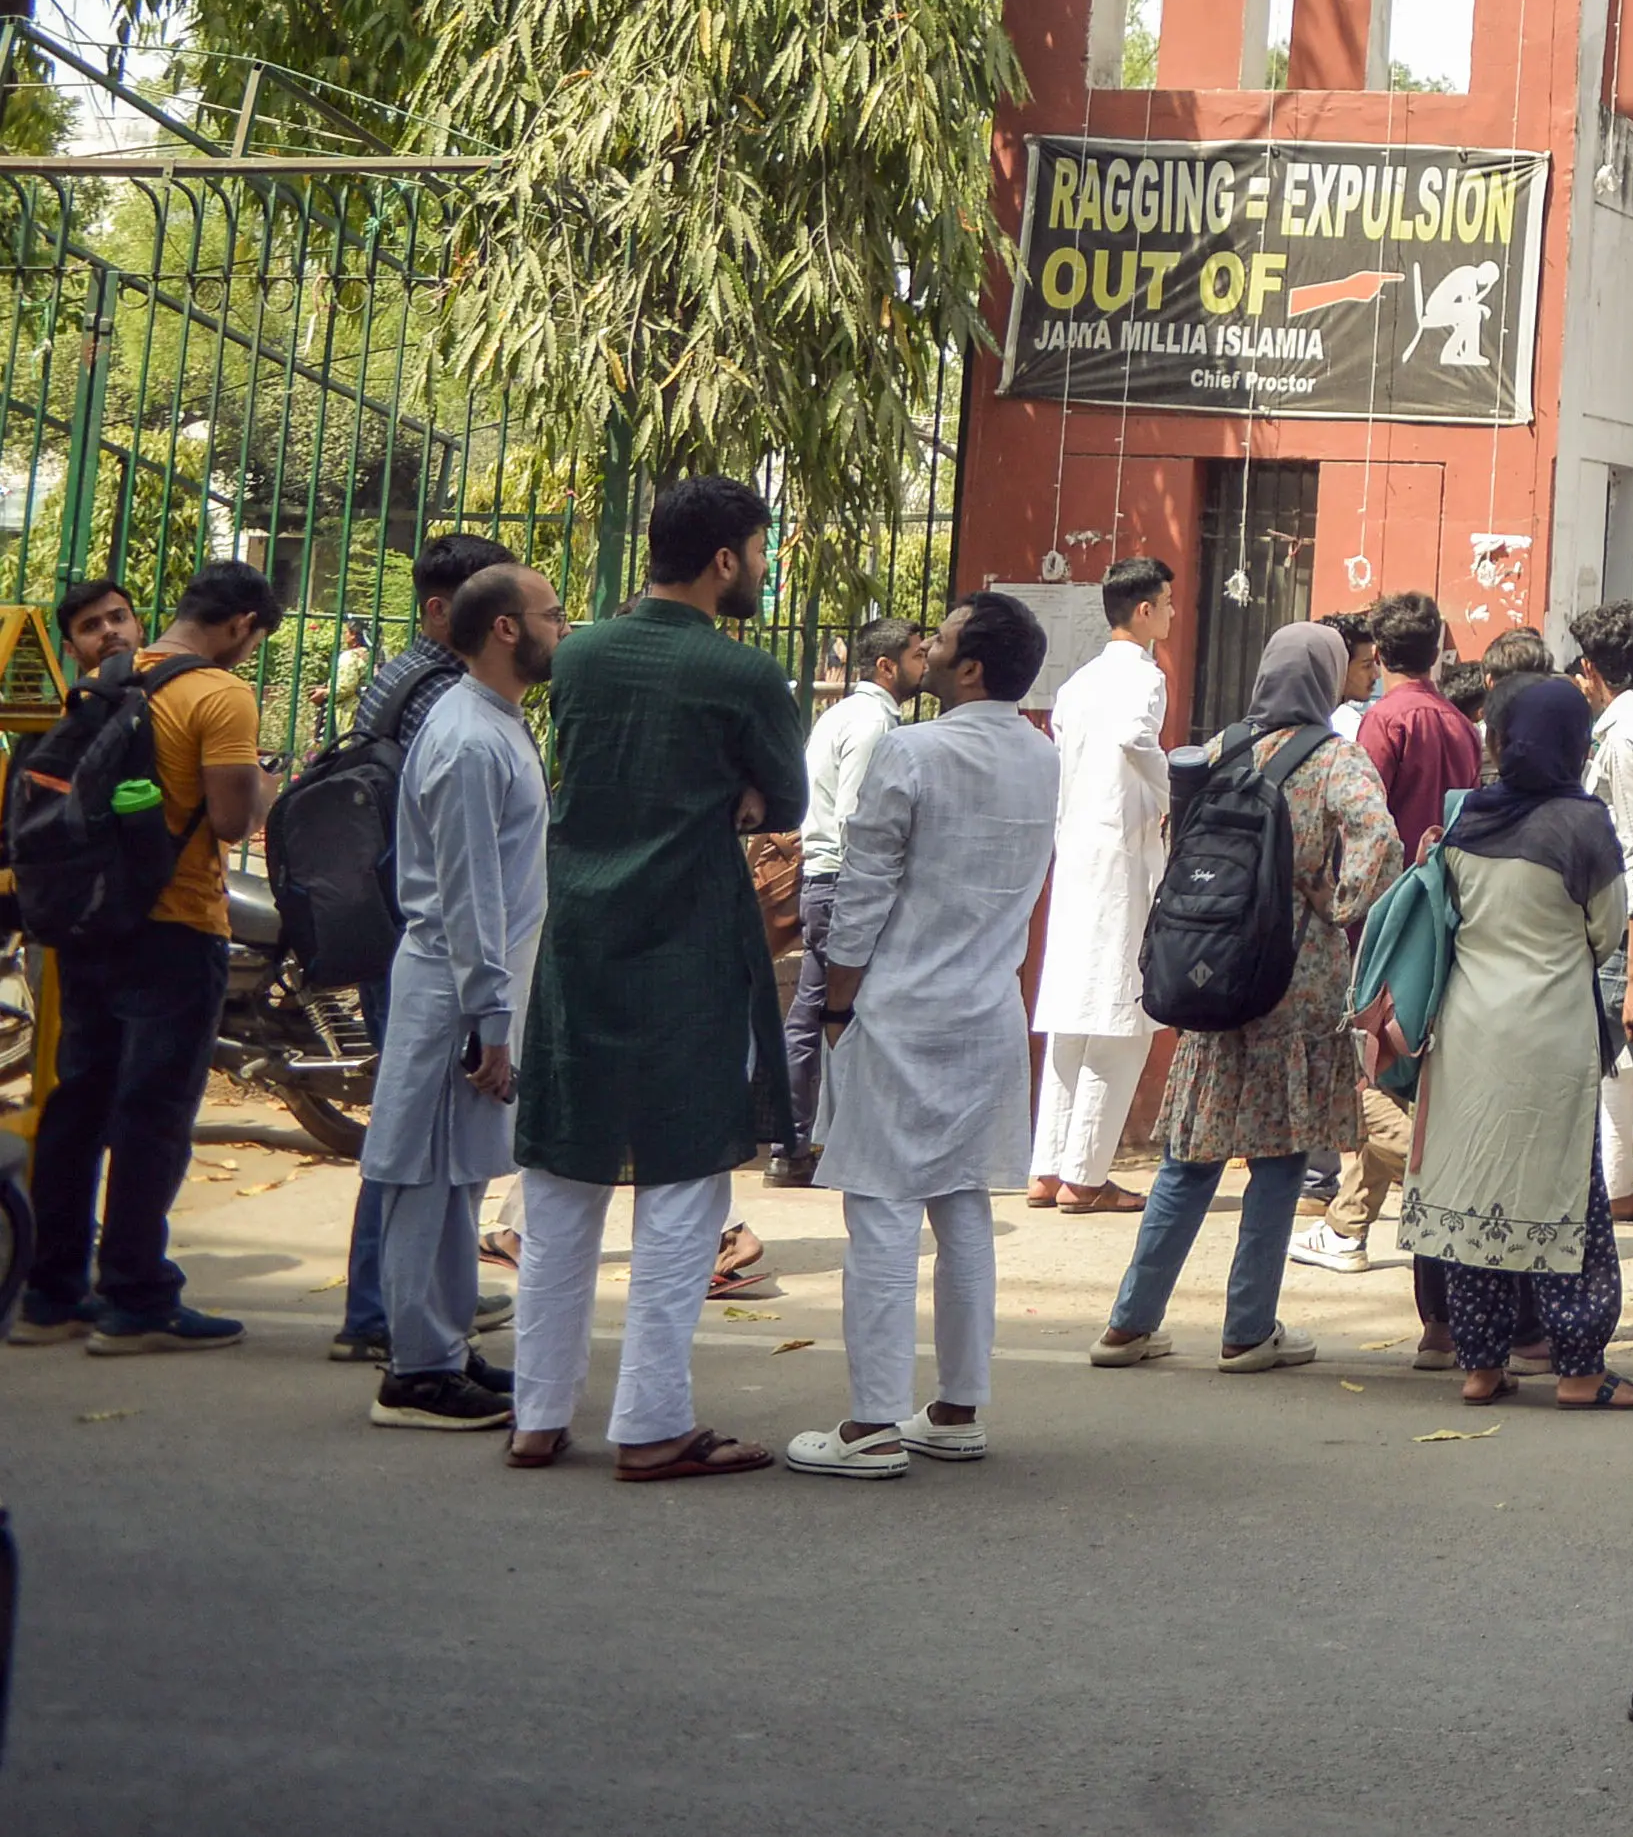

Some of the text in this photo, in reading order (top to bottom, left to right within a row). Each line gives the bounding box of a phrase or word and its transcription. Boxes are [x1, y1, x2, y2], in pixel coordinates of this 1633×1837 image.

[1049, 157, 1236, 235] RAGGING
[1280, 162, 1516, 244] EXPULSION
[1041, 246, 1287, 316] OUT OF
[1034, 318, 1325, 361] JAMIA MILLIA ISLAMIA
[1190, 368, 1316, 394] Chief Proctor
